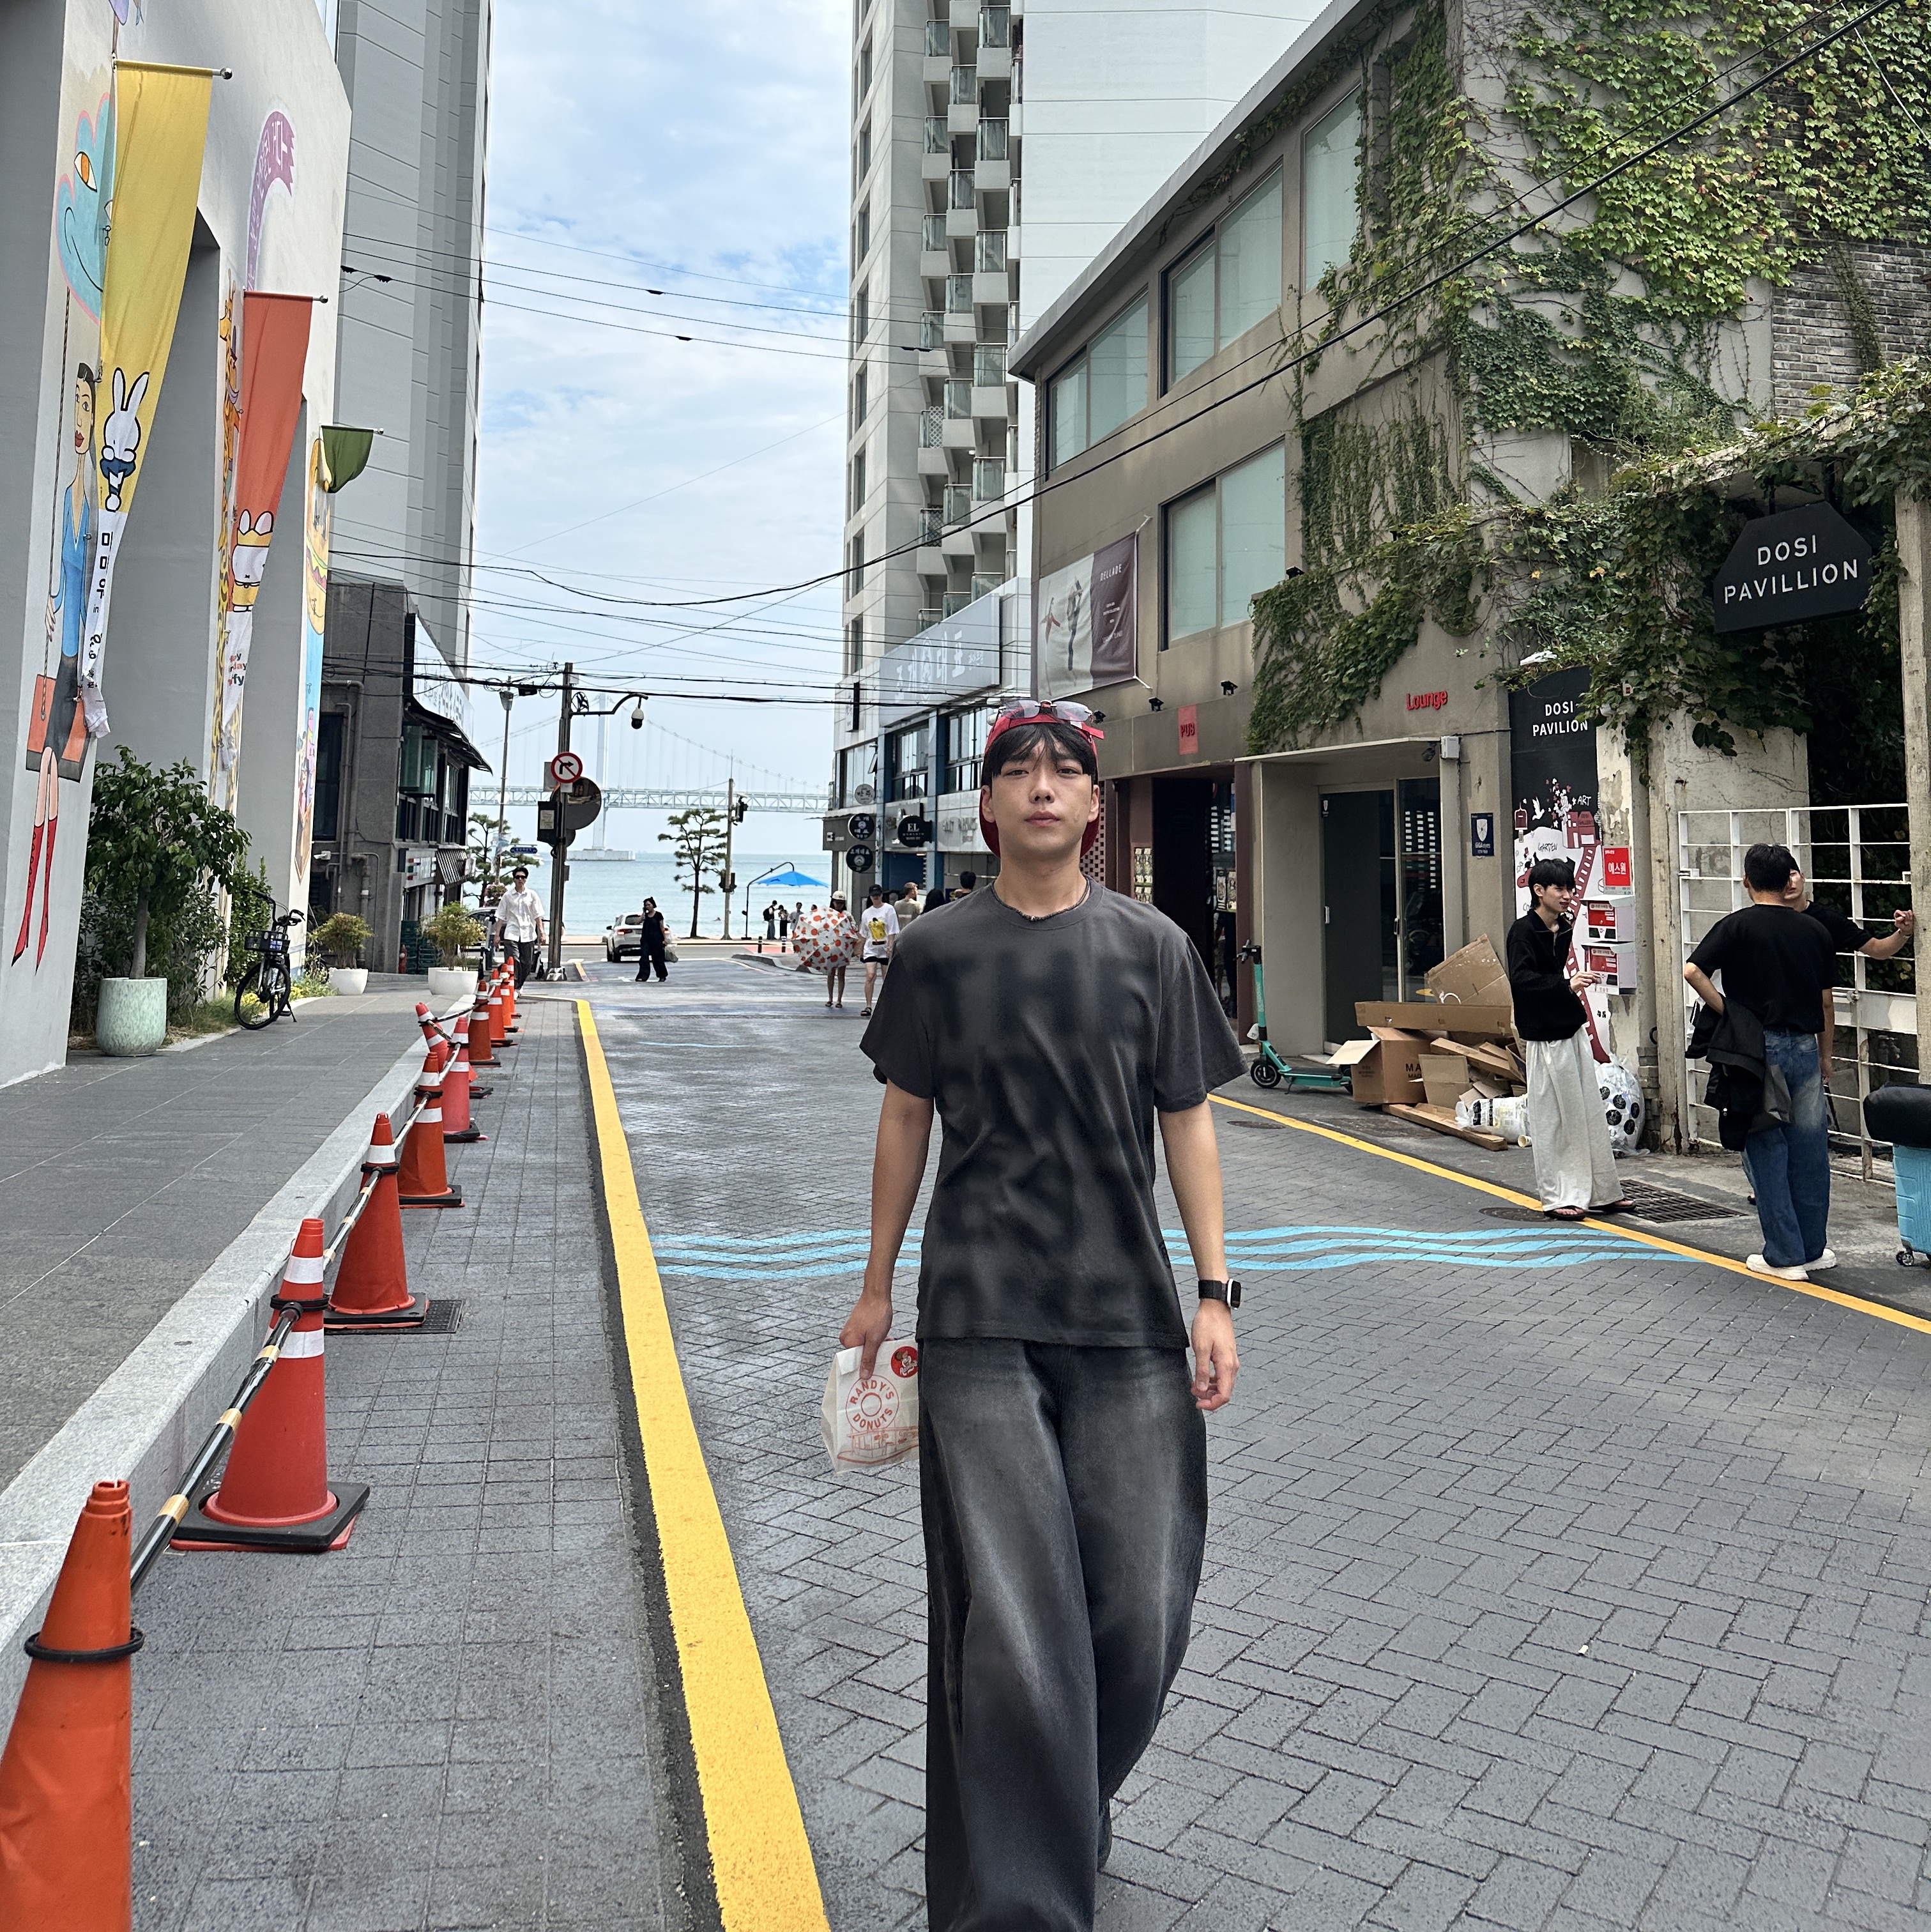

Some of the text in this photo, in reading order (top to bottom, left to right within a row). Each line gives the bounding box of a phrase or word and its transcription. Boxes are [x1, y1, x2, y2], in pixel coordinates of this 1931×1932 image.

[1757, 534, 1817, 566] DOSI
[1723, 559, 1859, 604] PAVILLION
[1407, 690, 1448, 710] Lounge
[1545, 700, 1573, 716] DOSI
[1179, 722, 1195, 737] PUB
[1532, 719, 1588, 737] PAVILION
[1577, 795, 1592, 806] ART
[907, 823, 920, 832] EL
[1405, 1063, 1421, 1071] MA
[850, 1379, 894, 1404] RANDY'S
[853, 1408, 893, 1430] DONUTS
